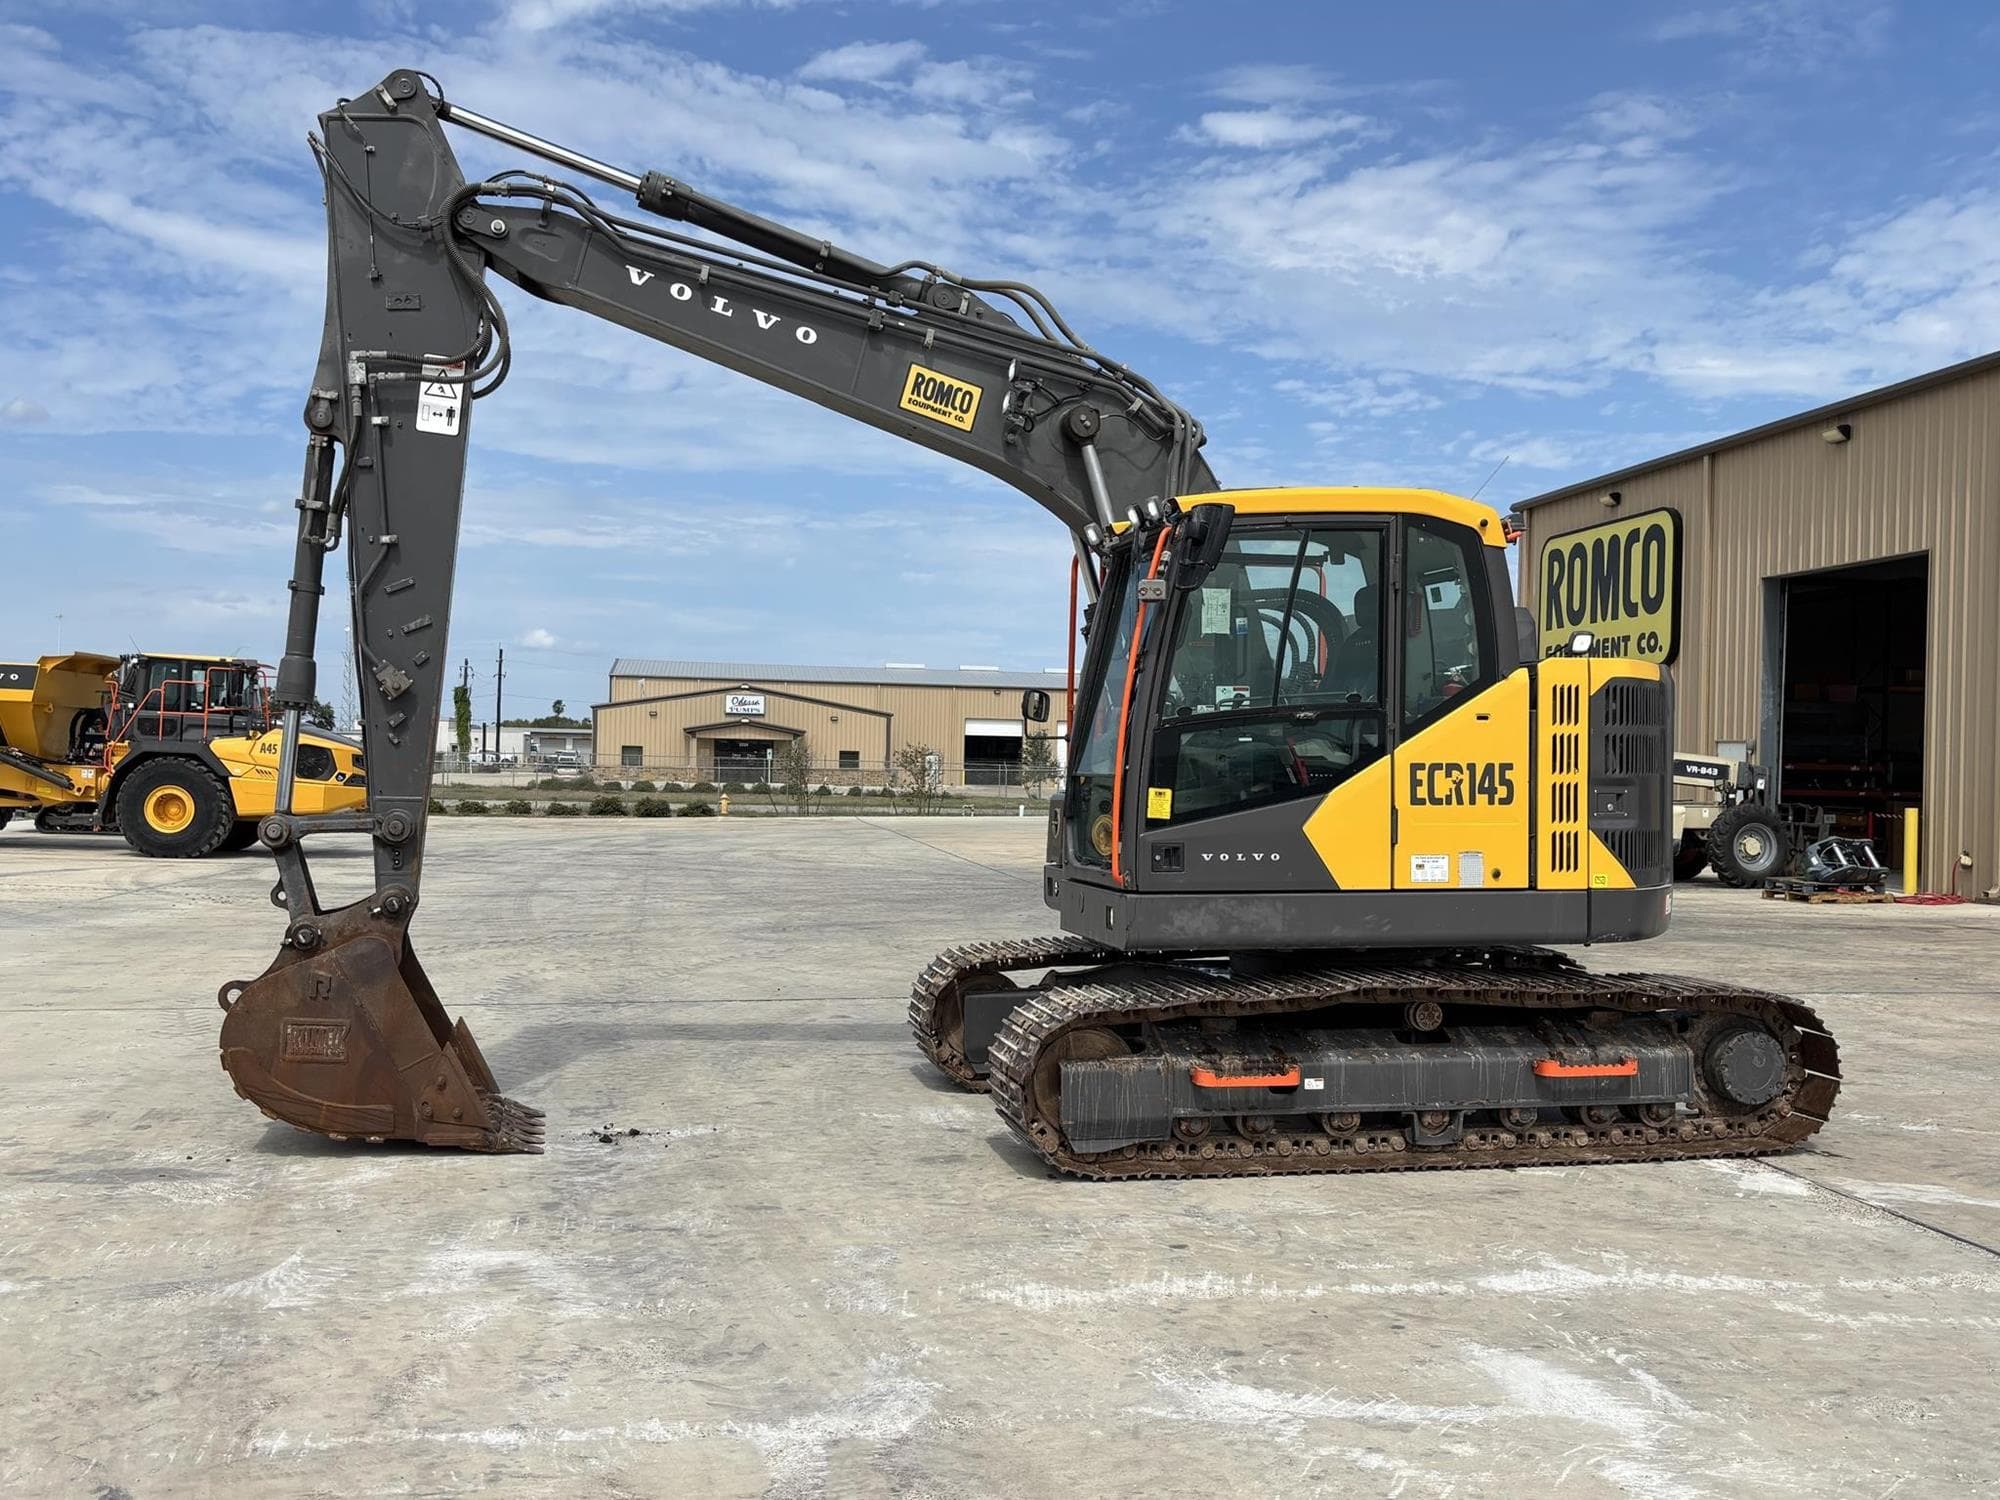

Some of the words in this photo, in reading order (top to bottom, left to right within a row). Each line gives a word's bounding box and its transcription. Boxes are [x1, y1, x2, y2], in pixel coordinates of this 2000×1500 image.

[625, 265, 817, 344] VOLVO
[911, 372, 974, 415] ROMCO
[908, 397, 952, 418] EQUIPMENT
[954, 414, 966, 424] CO.
[1546, 523, 1666, 631] ROMCO
[1637, 631, 1663, 654] CO.
[260, 743, 278, 755] A45
[1410, 763, 1515, 805] ECR145
[1686, 765, 1718, 776] VR-843
[1201, 853, 1280, 861] VOLVO
